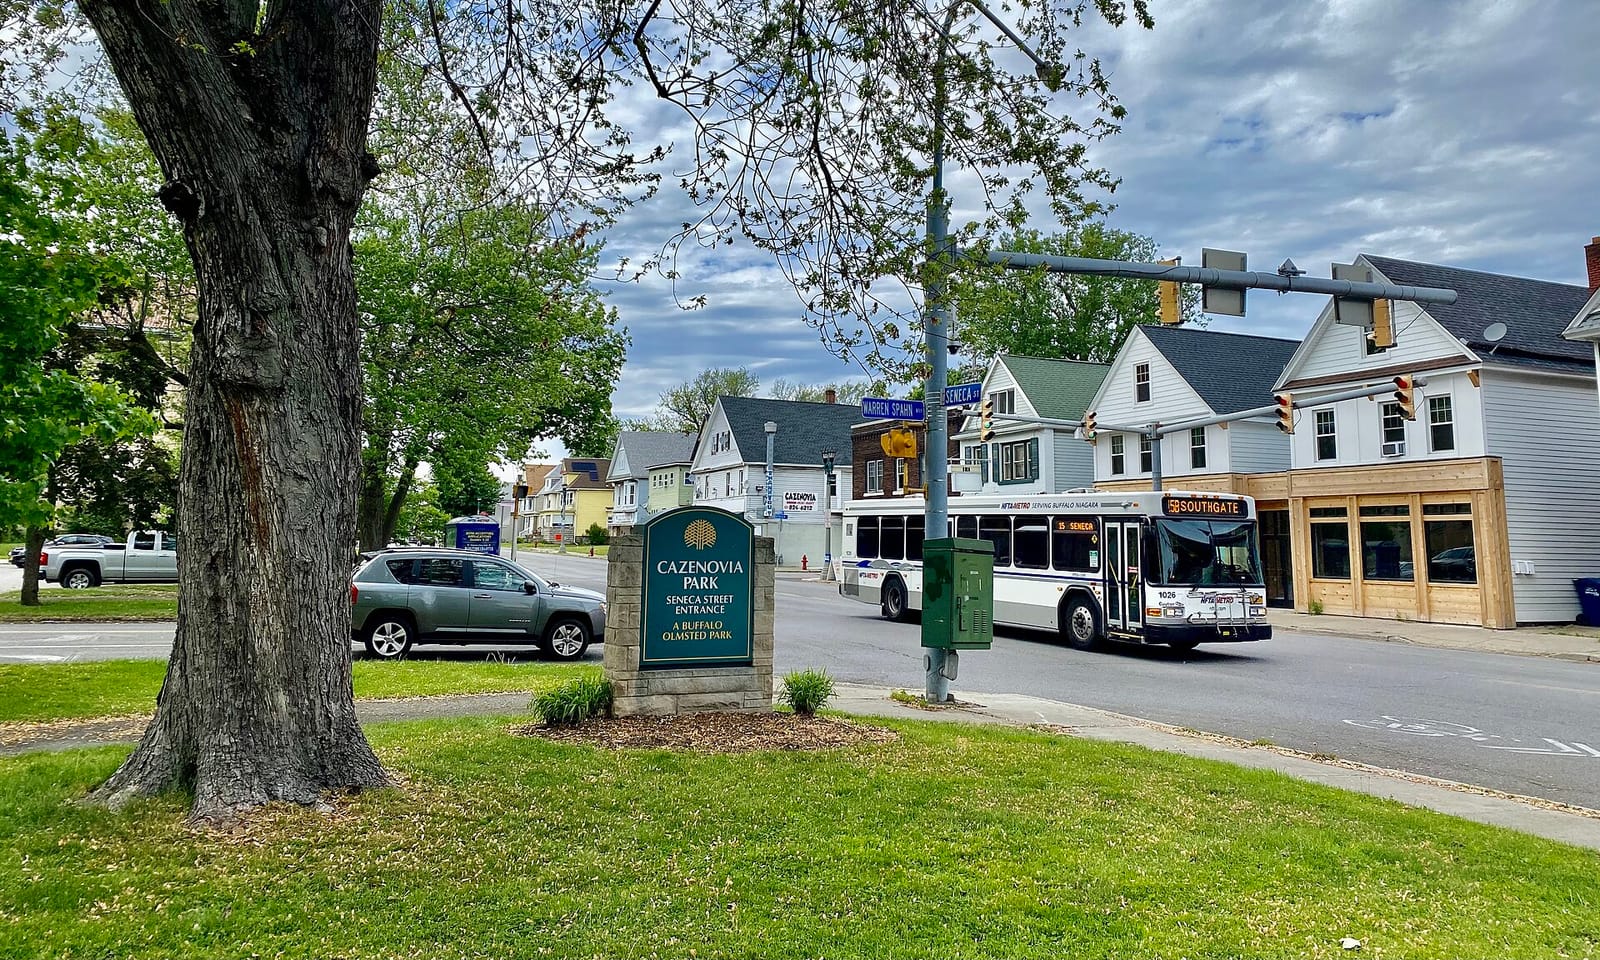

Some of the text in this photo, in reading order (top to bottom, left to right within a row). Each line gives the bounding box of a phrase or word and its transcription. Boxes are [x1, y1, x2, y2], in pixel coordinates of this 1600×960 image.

[945, 387, 980, 403] SENECA ST
[863, 401, 890, 416] WARREN
[891, 402, 913, 417] SPAHN
[785, 492, 816, 501] CAZENOVIA
[1180, 501, 1239, 514] SOUTHGATE
[1058, 522, 1094, 530] 15 SENECA
[657, 560, 743, 574] CAZENOVIA
[683, 576, 718, 590] PARK
[666, 594, 734, 604] SENECA STREET
[675, 605, 725, 615] ENTRANCE
[672, 621, 723, 630] A BUFFALO
[662, 631, 732, 641] OLMSTED PARK
